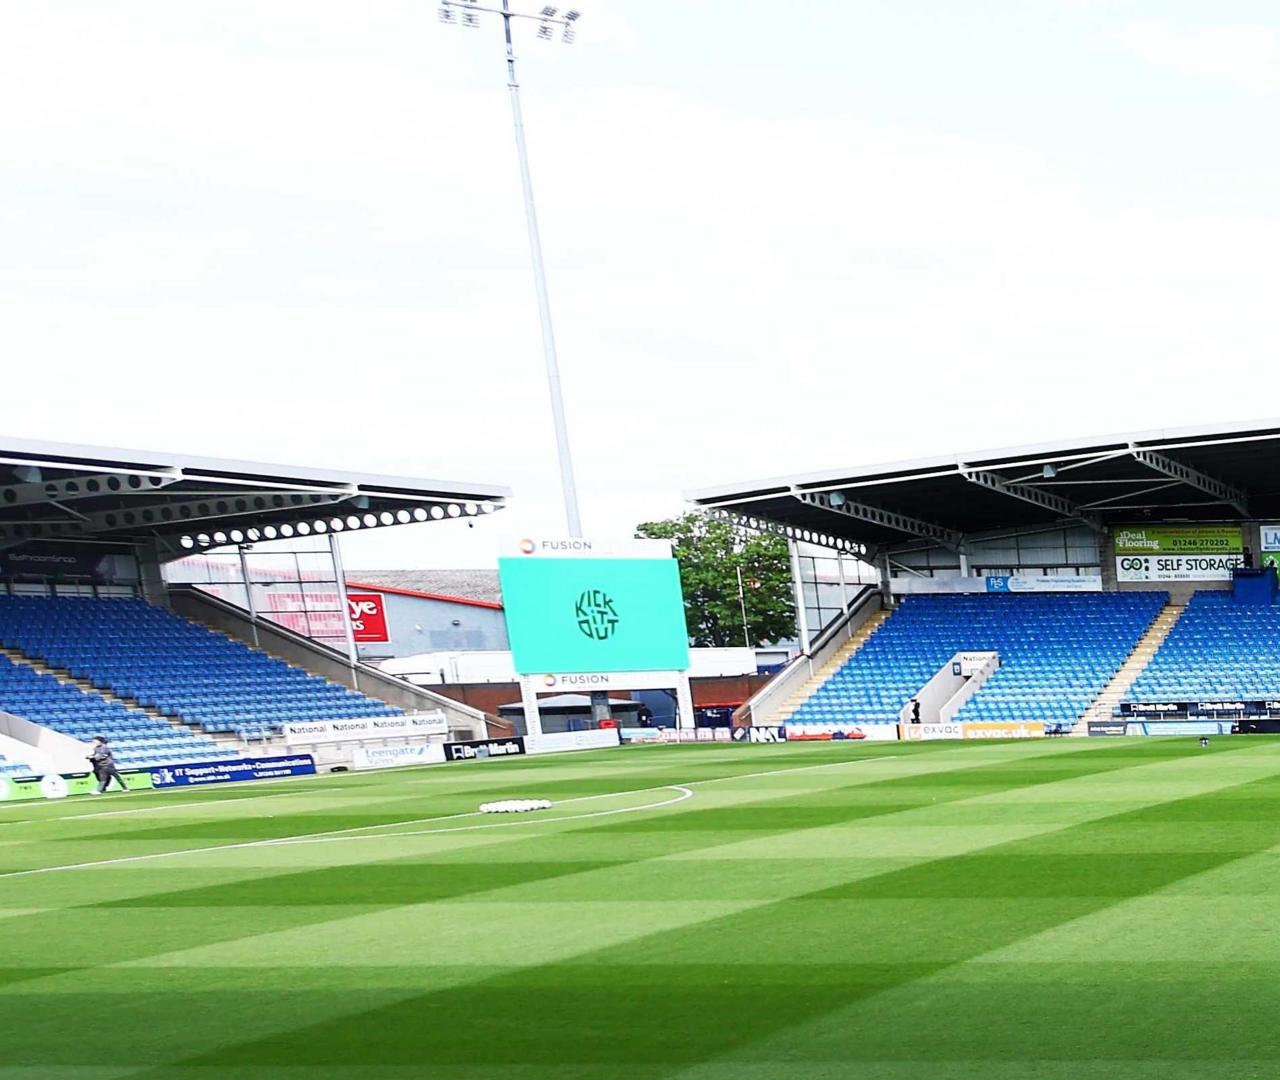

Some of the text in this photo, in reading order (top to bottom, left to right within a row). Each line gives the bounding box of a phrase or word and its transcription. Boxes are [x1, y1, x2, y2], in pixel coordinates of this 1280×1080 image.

[541, 541, 592, 550] FUSION
[1116, 537, 1159, 549] Flooring
[1157, 558, 1182, 571] SELF
[1185, 558, 1241, 571] STORAGE
[575, 590, 618, 618] KICK
[578, 619, 619, 640] OUT
[561, 675, 609, 685] FUSION
[333, 721, 368, 731] National
[373, 719, 407, 728] National
[412, 717, 444, 726] National
[290, 724, 326, 734] National
[923, 725, 959, 735] exvac
